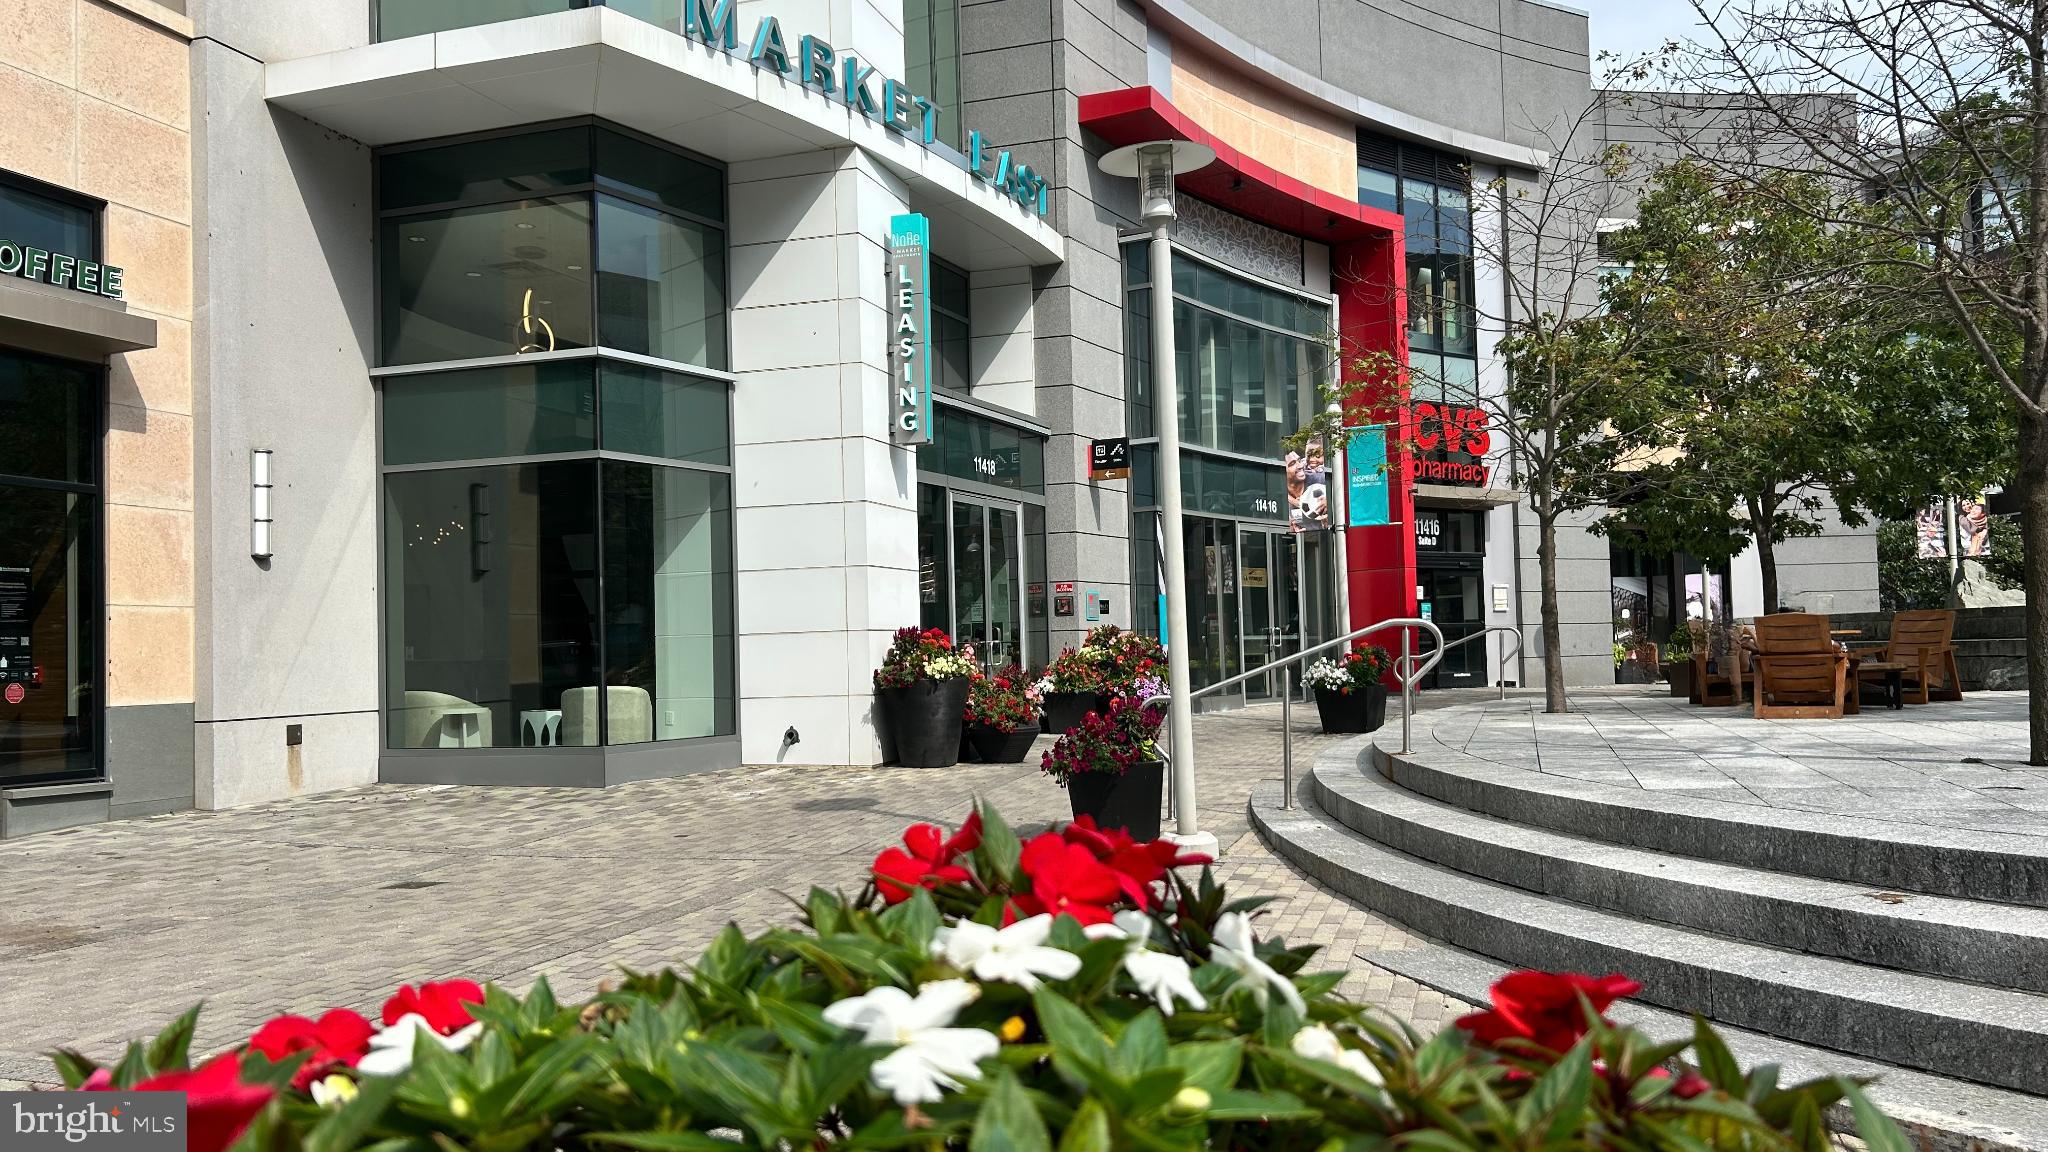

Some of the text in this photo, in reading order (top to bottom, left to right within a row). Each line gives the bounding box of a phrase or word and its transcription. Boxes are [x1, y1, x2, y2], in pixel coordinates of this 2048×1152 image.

[684, 0, 1049, 217] MARKET EAST
[897, 264, 919, 432] LEASING
[1412, 402, 1490, 457] CVS
[973, 456, 996, 476] 11418
[1412, 454, 1490, 488] pharmacy
[1255, 499, 1278, 513] 11416
[1414, 518, 1440, 535] 11416
